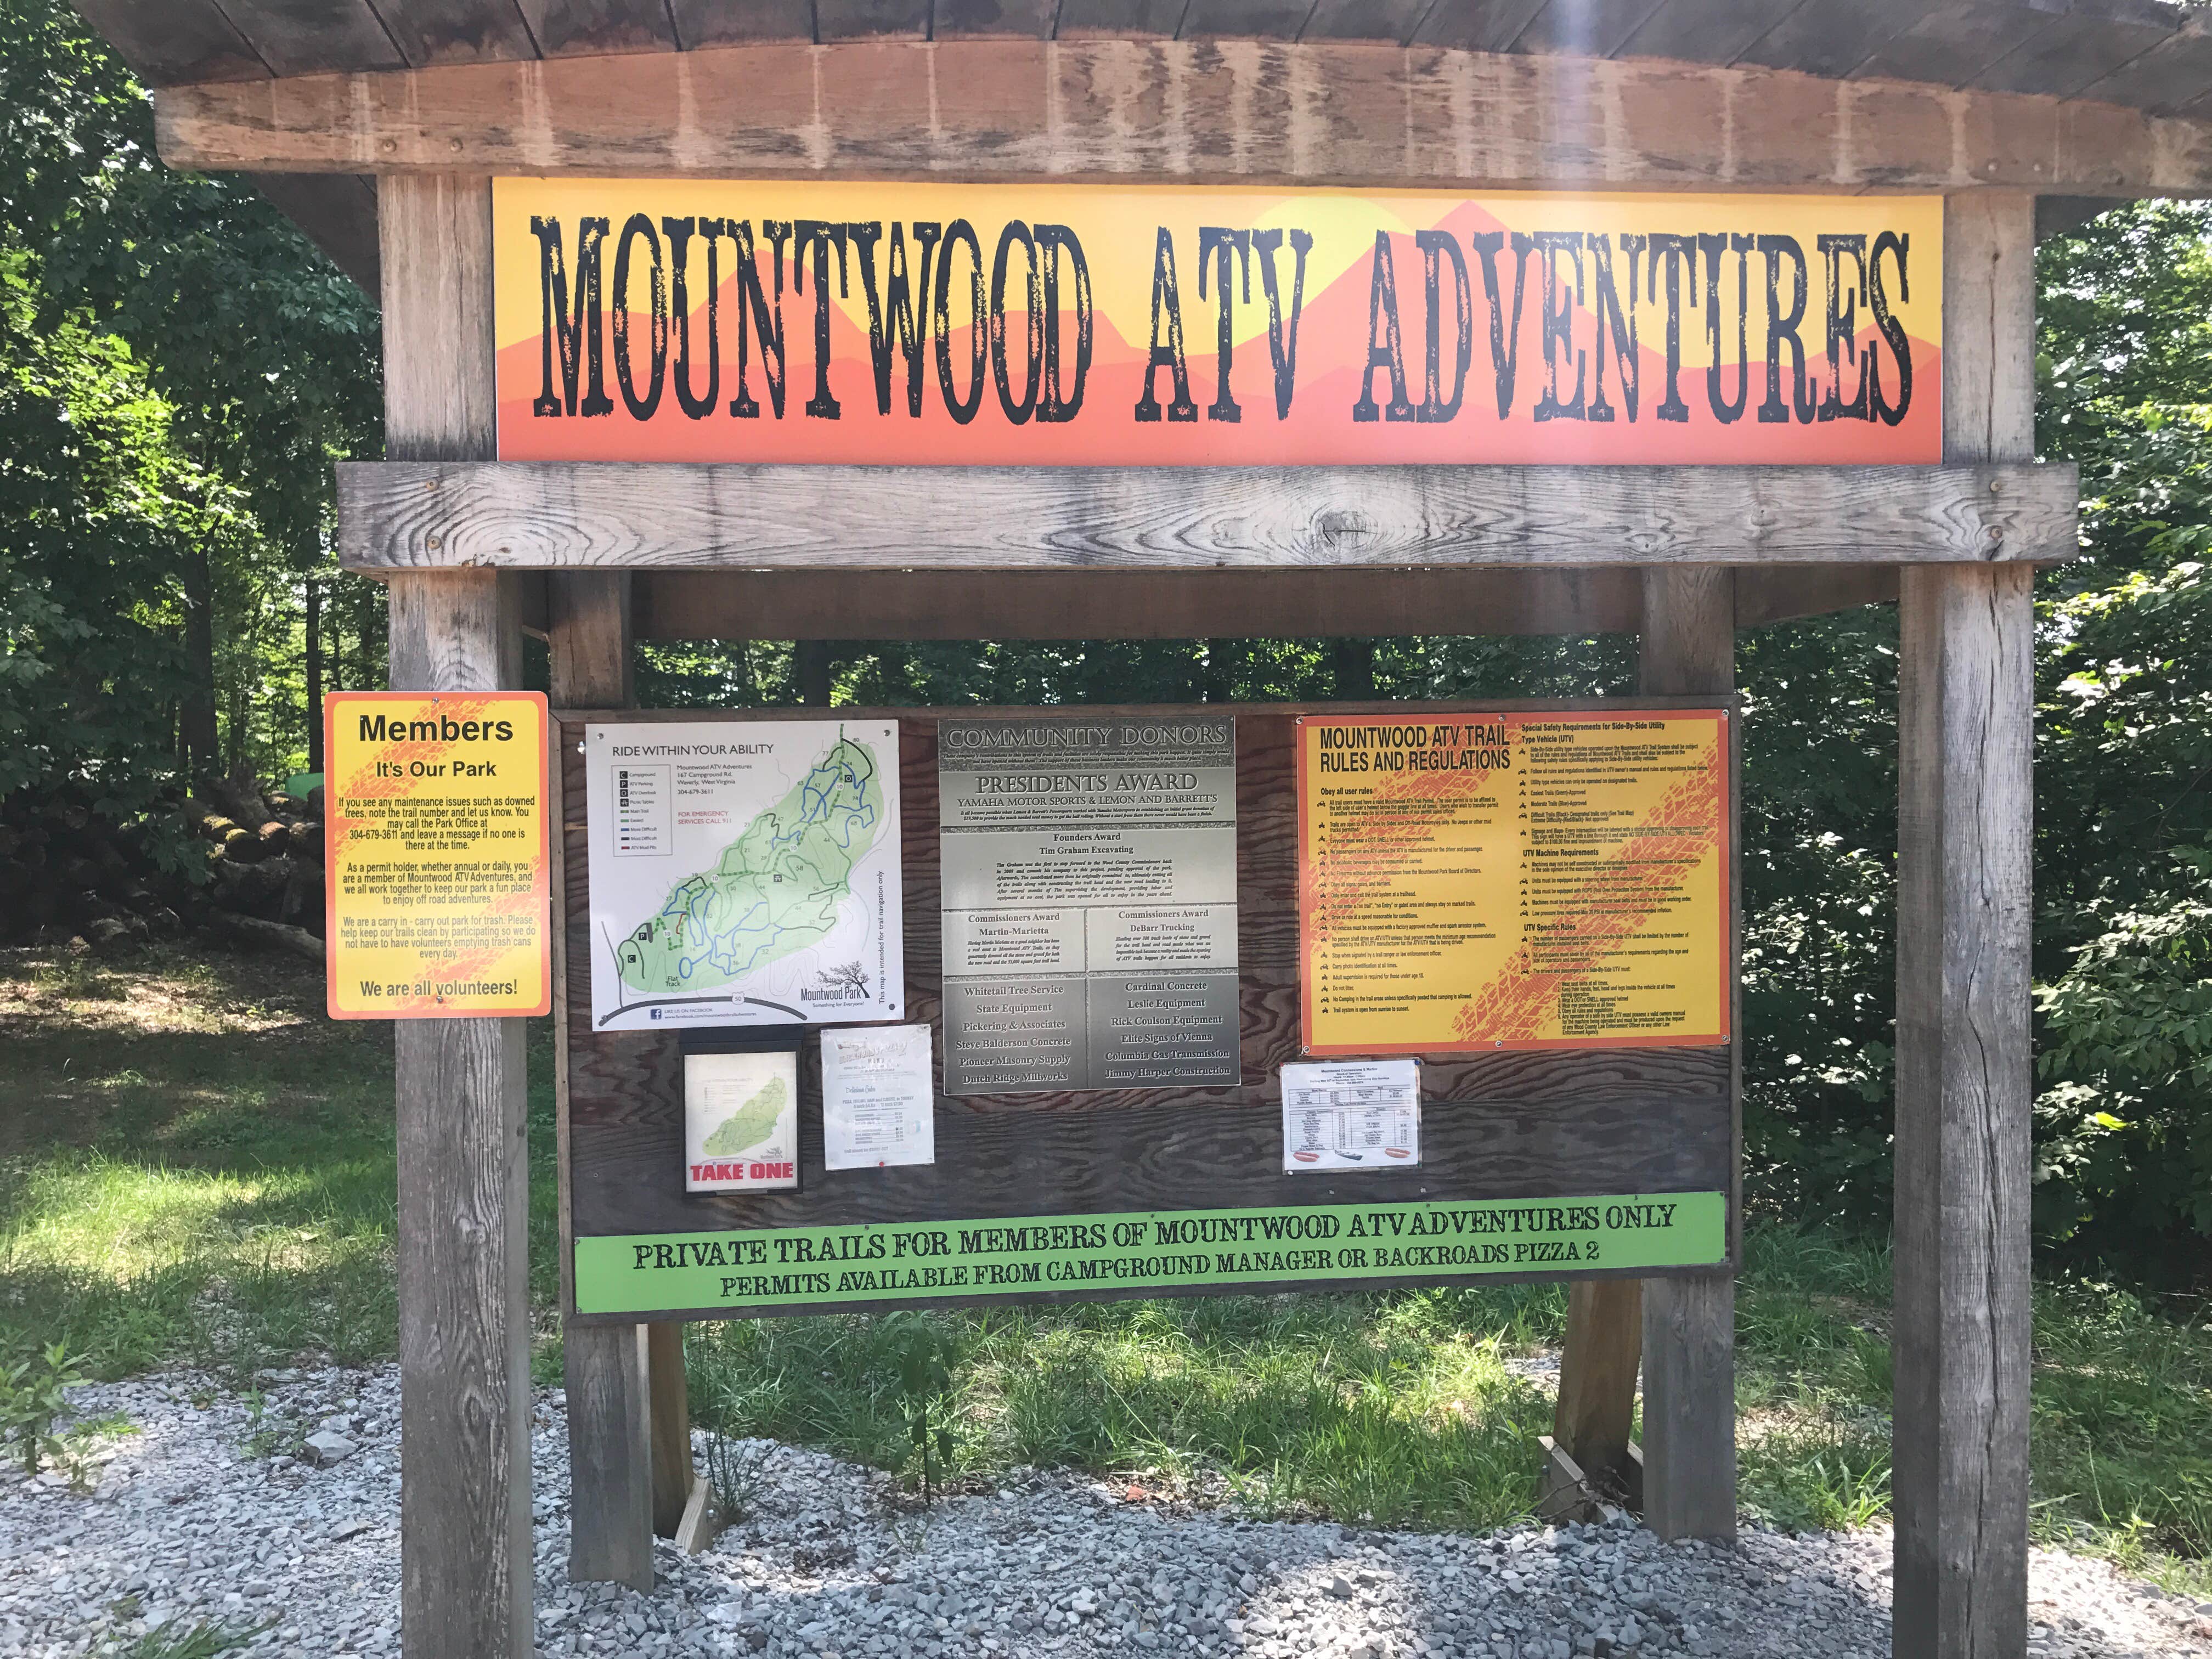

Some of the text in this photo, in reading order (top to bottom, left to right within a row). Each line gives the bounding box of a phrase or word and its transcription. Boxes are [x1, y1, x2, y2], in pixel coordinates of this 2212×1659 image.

[529, 215, 1912, 427] MOUNTWOOD ATV ADVENTURES
[360, 715, 513, 741] Members
[1544, 724, 1561, 732] Safety
[1562, 723, 1601, 731] Requirements
[1612, 722, 1647, 731] Side-By-Side
[947, 725, 1227, 747] COMMUNITY DONORS
[1321, 725, 1510, 749] MOUNTWOOD ATV TRAIL
[1559, 735, 1573, 743] (UTV)
[613, 744, 774, 756] RIDE WITHIN YOUR ABILITY
[1321, 748, 1510, 772] RULES AND REGULATIONS
[377, 761, 496, 777] It's Our Park
[975, 774, 1198, 794] PRESIDENTS AWARD
[339, 797, 343, 806] If
[346, 799, 360, 808] you
[379, 799, 392, 808] any
[395, 797, 443, 806] maintenance
[446, 797, 470, 806] issues
[473, 797, 491, 806] such
[505, 796, 534, 805] downed
[957, 799, 1005, 807] YAMAHA
[1098, 796, 1136, 804] LEMON
[345, 808, 366, 817] trees,
[369, 809, 386, 817] note
[388, 808, 400, 817] the
[403, 808, 417, 817] trail
[420, 808, 449, 817] number
[451, 807, 465, 818] and
[468, 807, 477, 816] let
[492, 807, 512, 816] know.
[516, 807, 529, 816] You
[388, 818, 487, 830] may call the Park Office at
[350, 830, 397, 839] 304-679-3611
[399, 830, 414, 839] and
[417, 830, 437, 839] leave
[447, 831, 480, 840] message
[483, 829, 487, 838] if
[519, 829, 524, 838] is
[1053, 833, 1120, 843] Founders Award
[405, 840, 470, 850] there at the time.
[1057, 847, 1089, 856] Graham
[1091, 846, 1133, 854] Excavating
[968, 914, 1030, 922] Commissioners
[979, 927, 1049, 935] Martin-Marietta
[1160, 923, 1194, 932] Trucking
[360, 979, 517, 996] We are all volunteers!
[964, 985, 1063, 996] Whitetail Tree Service
[1125, 982, 1207, 992] Cardinal Concrete
[801, 986, 861, 1001] Mountwood Park
[977, 1002, 1052, 1014] State Equipment
[1128, 999, 1206, 1009] Leslie Equipment
[690, 1163, 793, 1181] TAKE ONE
[633, 1204, 1677, 1269] PRIVATE TRAILS FOR MEMBERS OF MOUNTWOOD ATV ADVENTURES ONLY
[720, 1241, 1599, 1297] PERMITS AVAILABLE FROM CAMPGROUND MANAGER OR BACKROADS PIZZA 2
